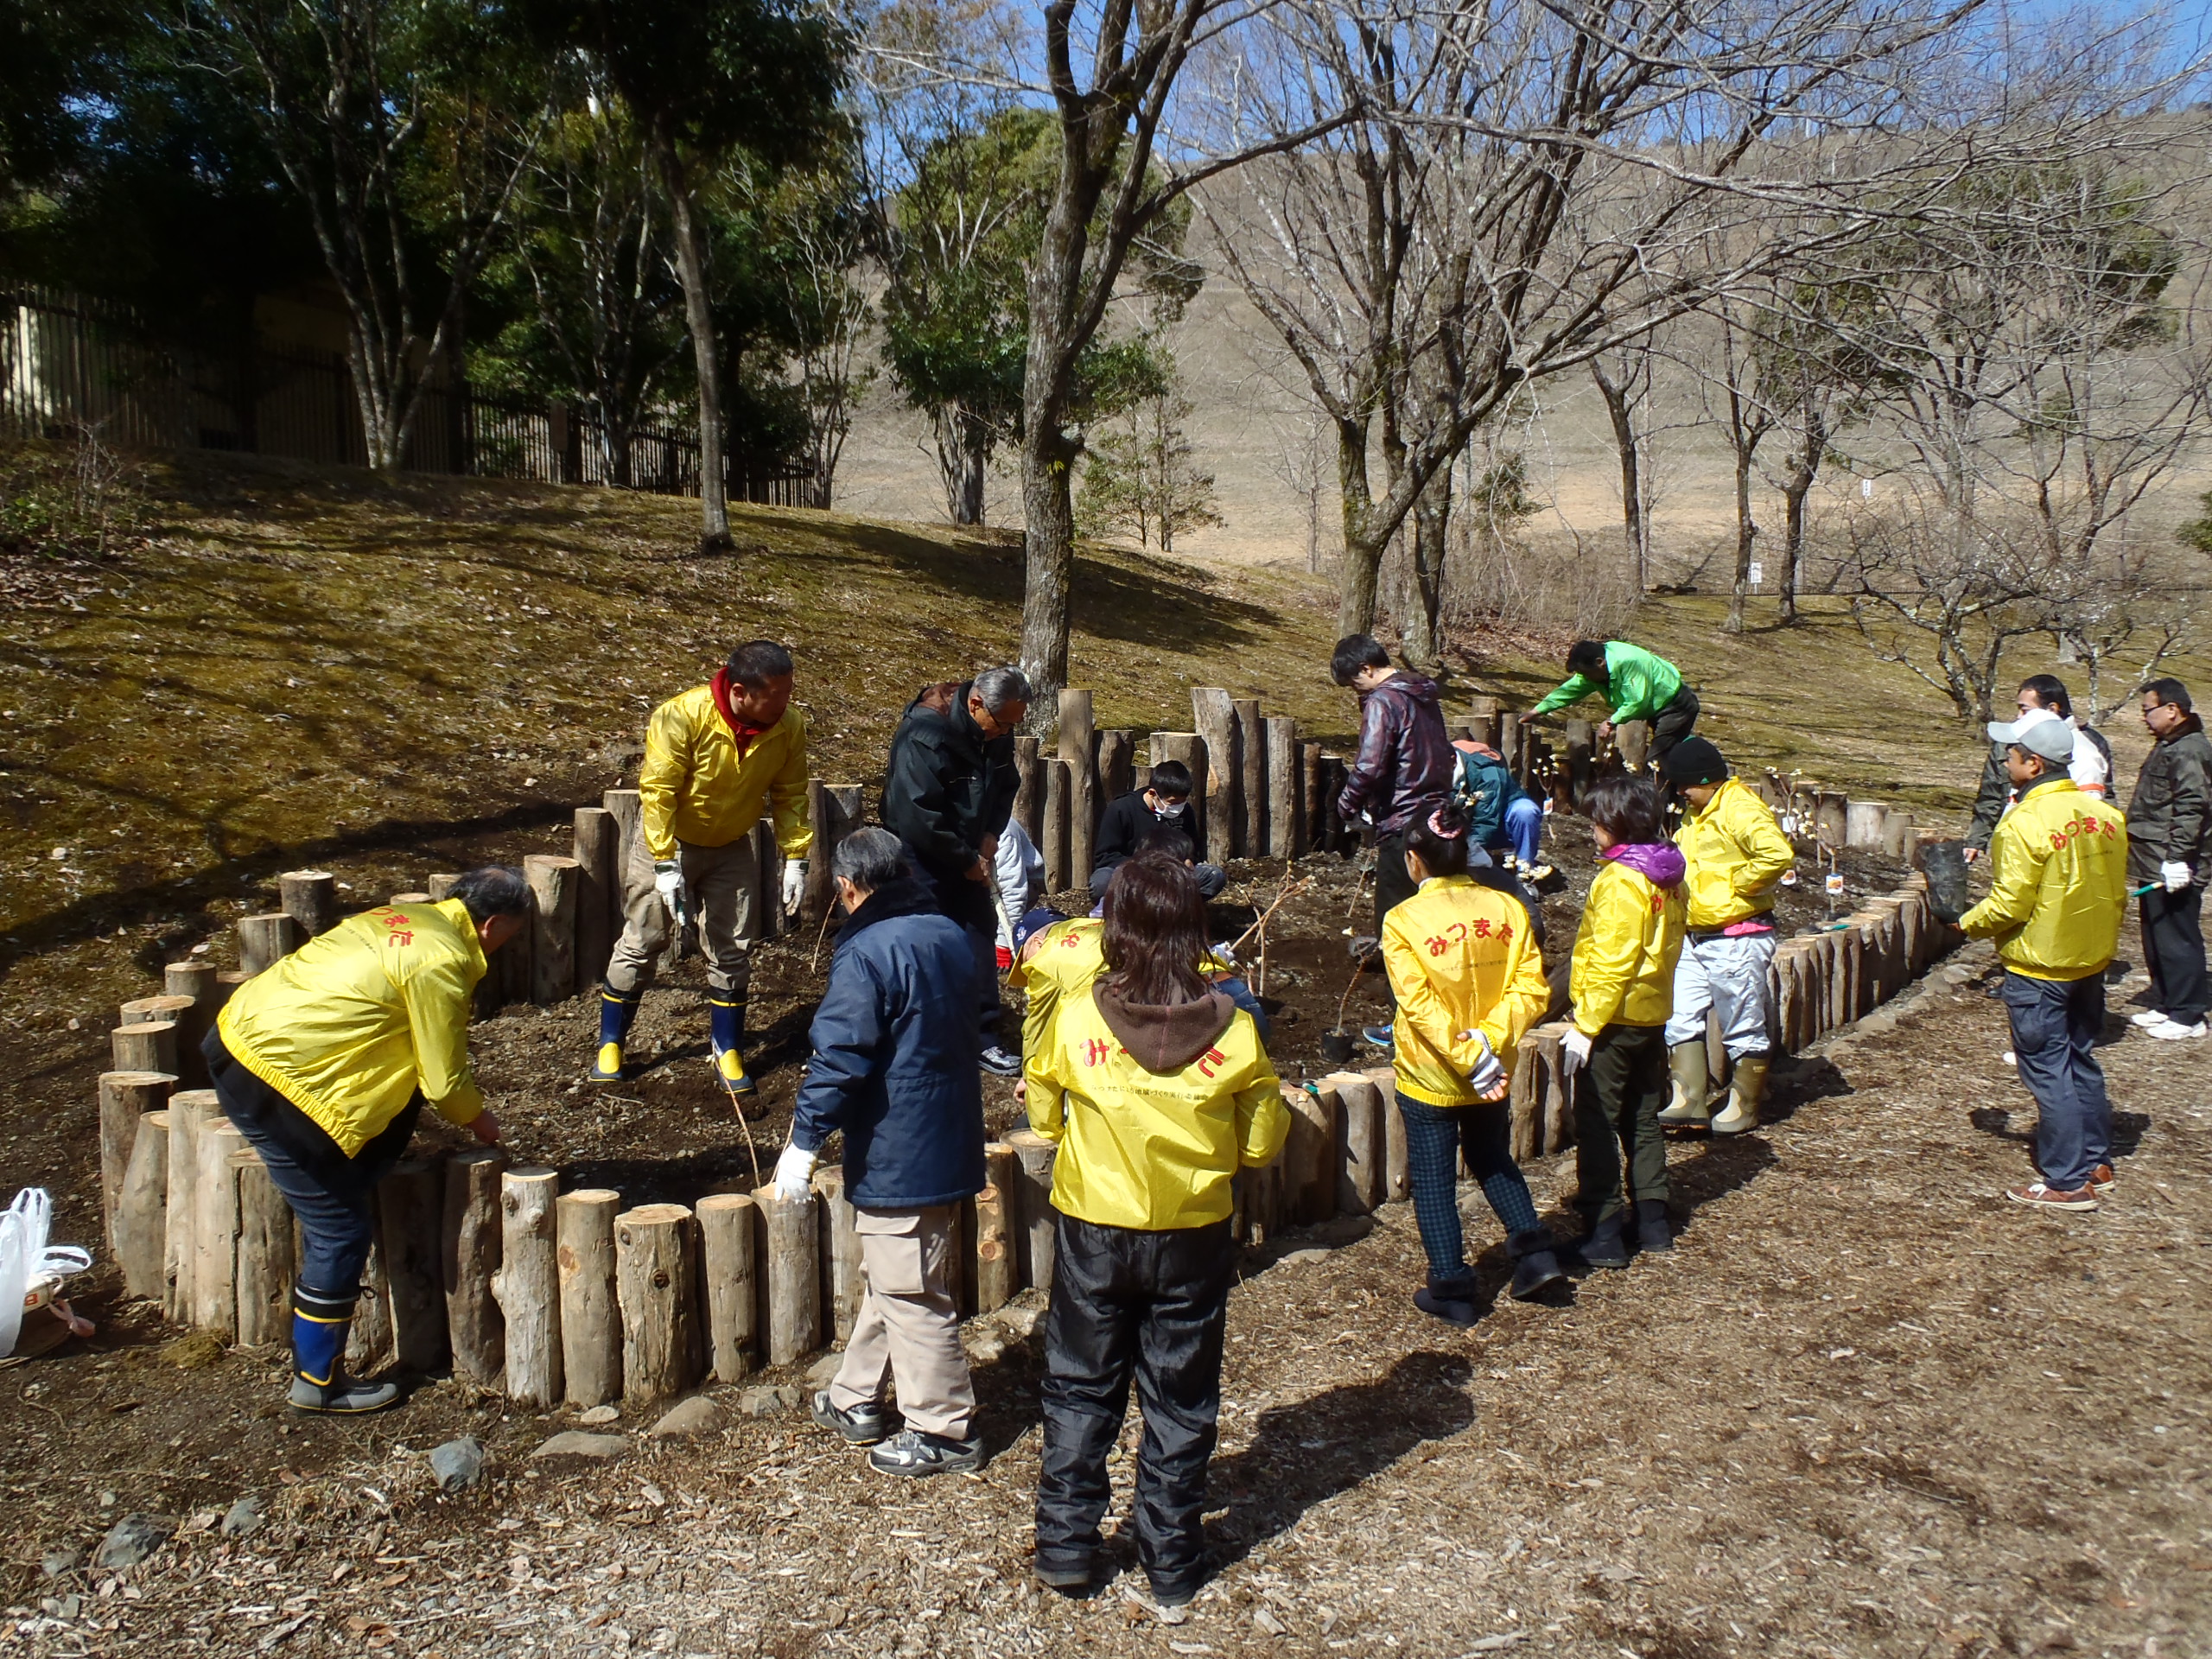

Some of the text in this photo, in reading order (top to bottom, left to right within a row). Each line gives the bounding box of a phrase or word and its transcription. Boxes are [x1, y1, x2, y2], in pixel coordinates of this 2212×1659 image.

[2050, 817, 2117, 850] みつまた
[1424, 918, 1514, 957] みつまた
[1079, 1038, 1225, 1078] みた
